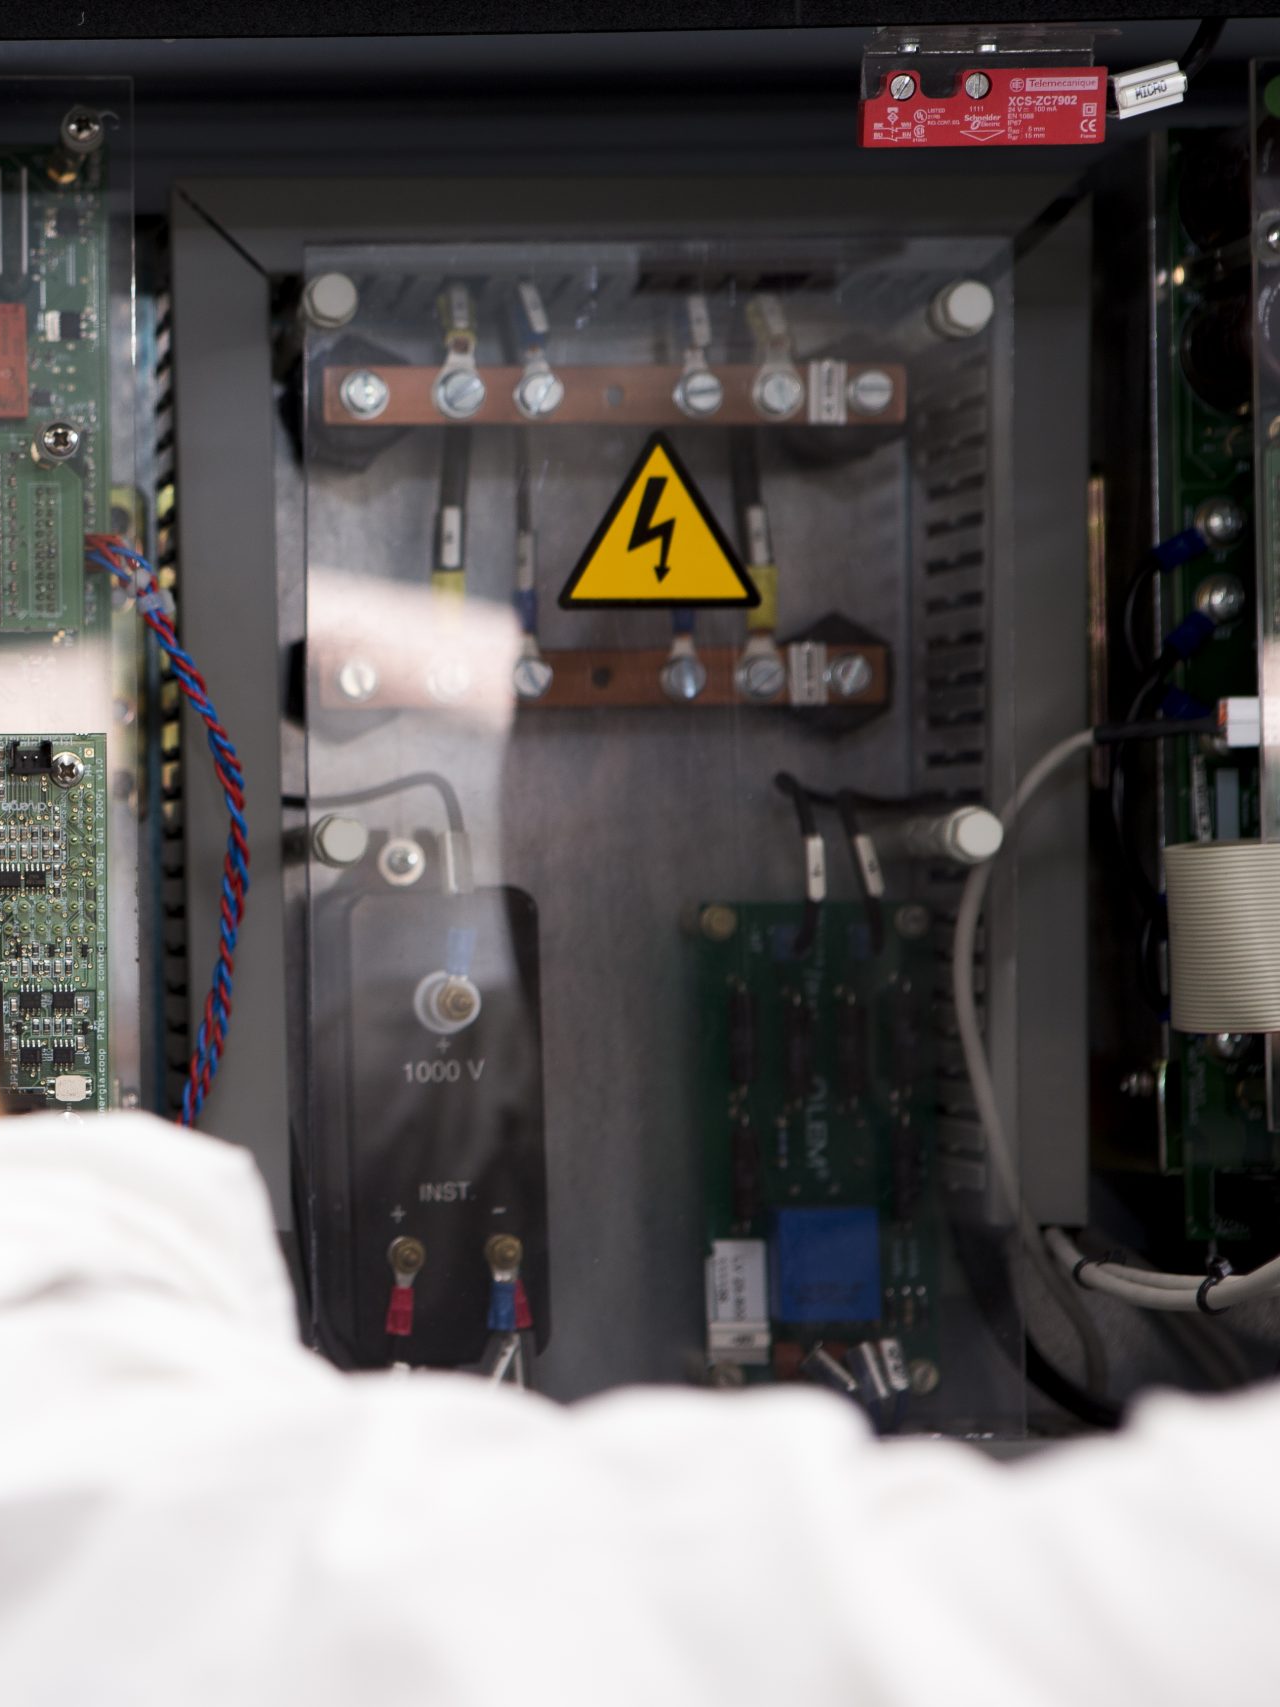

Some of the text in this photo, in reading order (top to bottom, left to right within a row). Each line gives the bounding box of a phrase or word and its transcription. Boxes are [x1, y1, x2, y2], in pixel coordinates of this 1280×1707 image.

[1029, 78, 1096, 89] Telemecanique
[1135, 80, 1167, 100] MICRO
[1008, 95, 1078, 107] XCS-ZC7902
[964, 113, 1002, 122] Schneider
[403, 1059, 487, 1084] 1000 V
